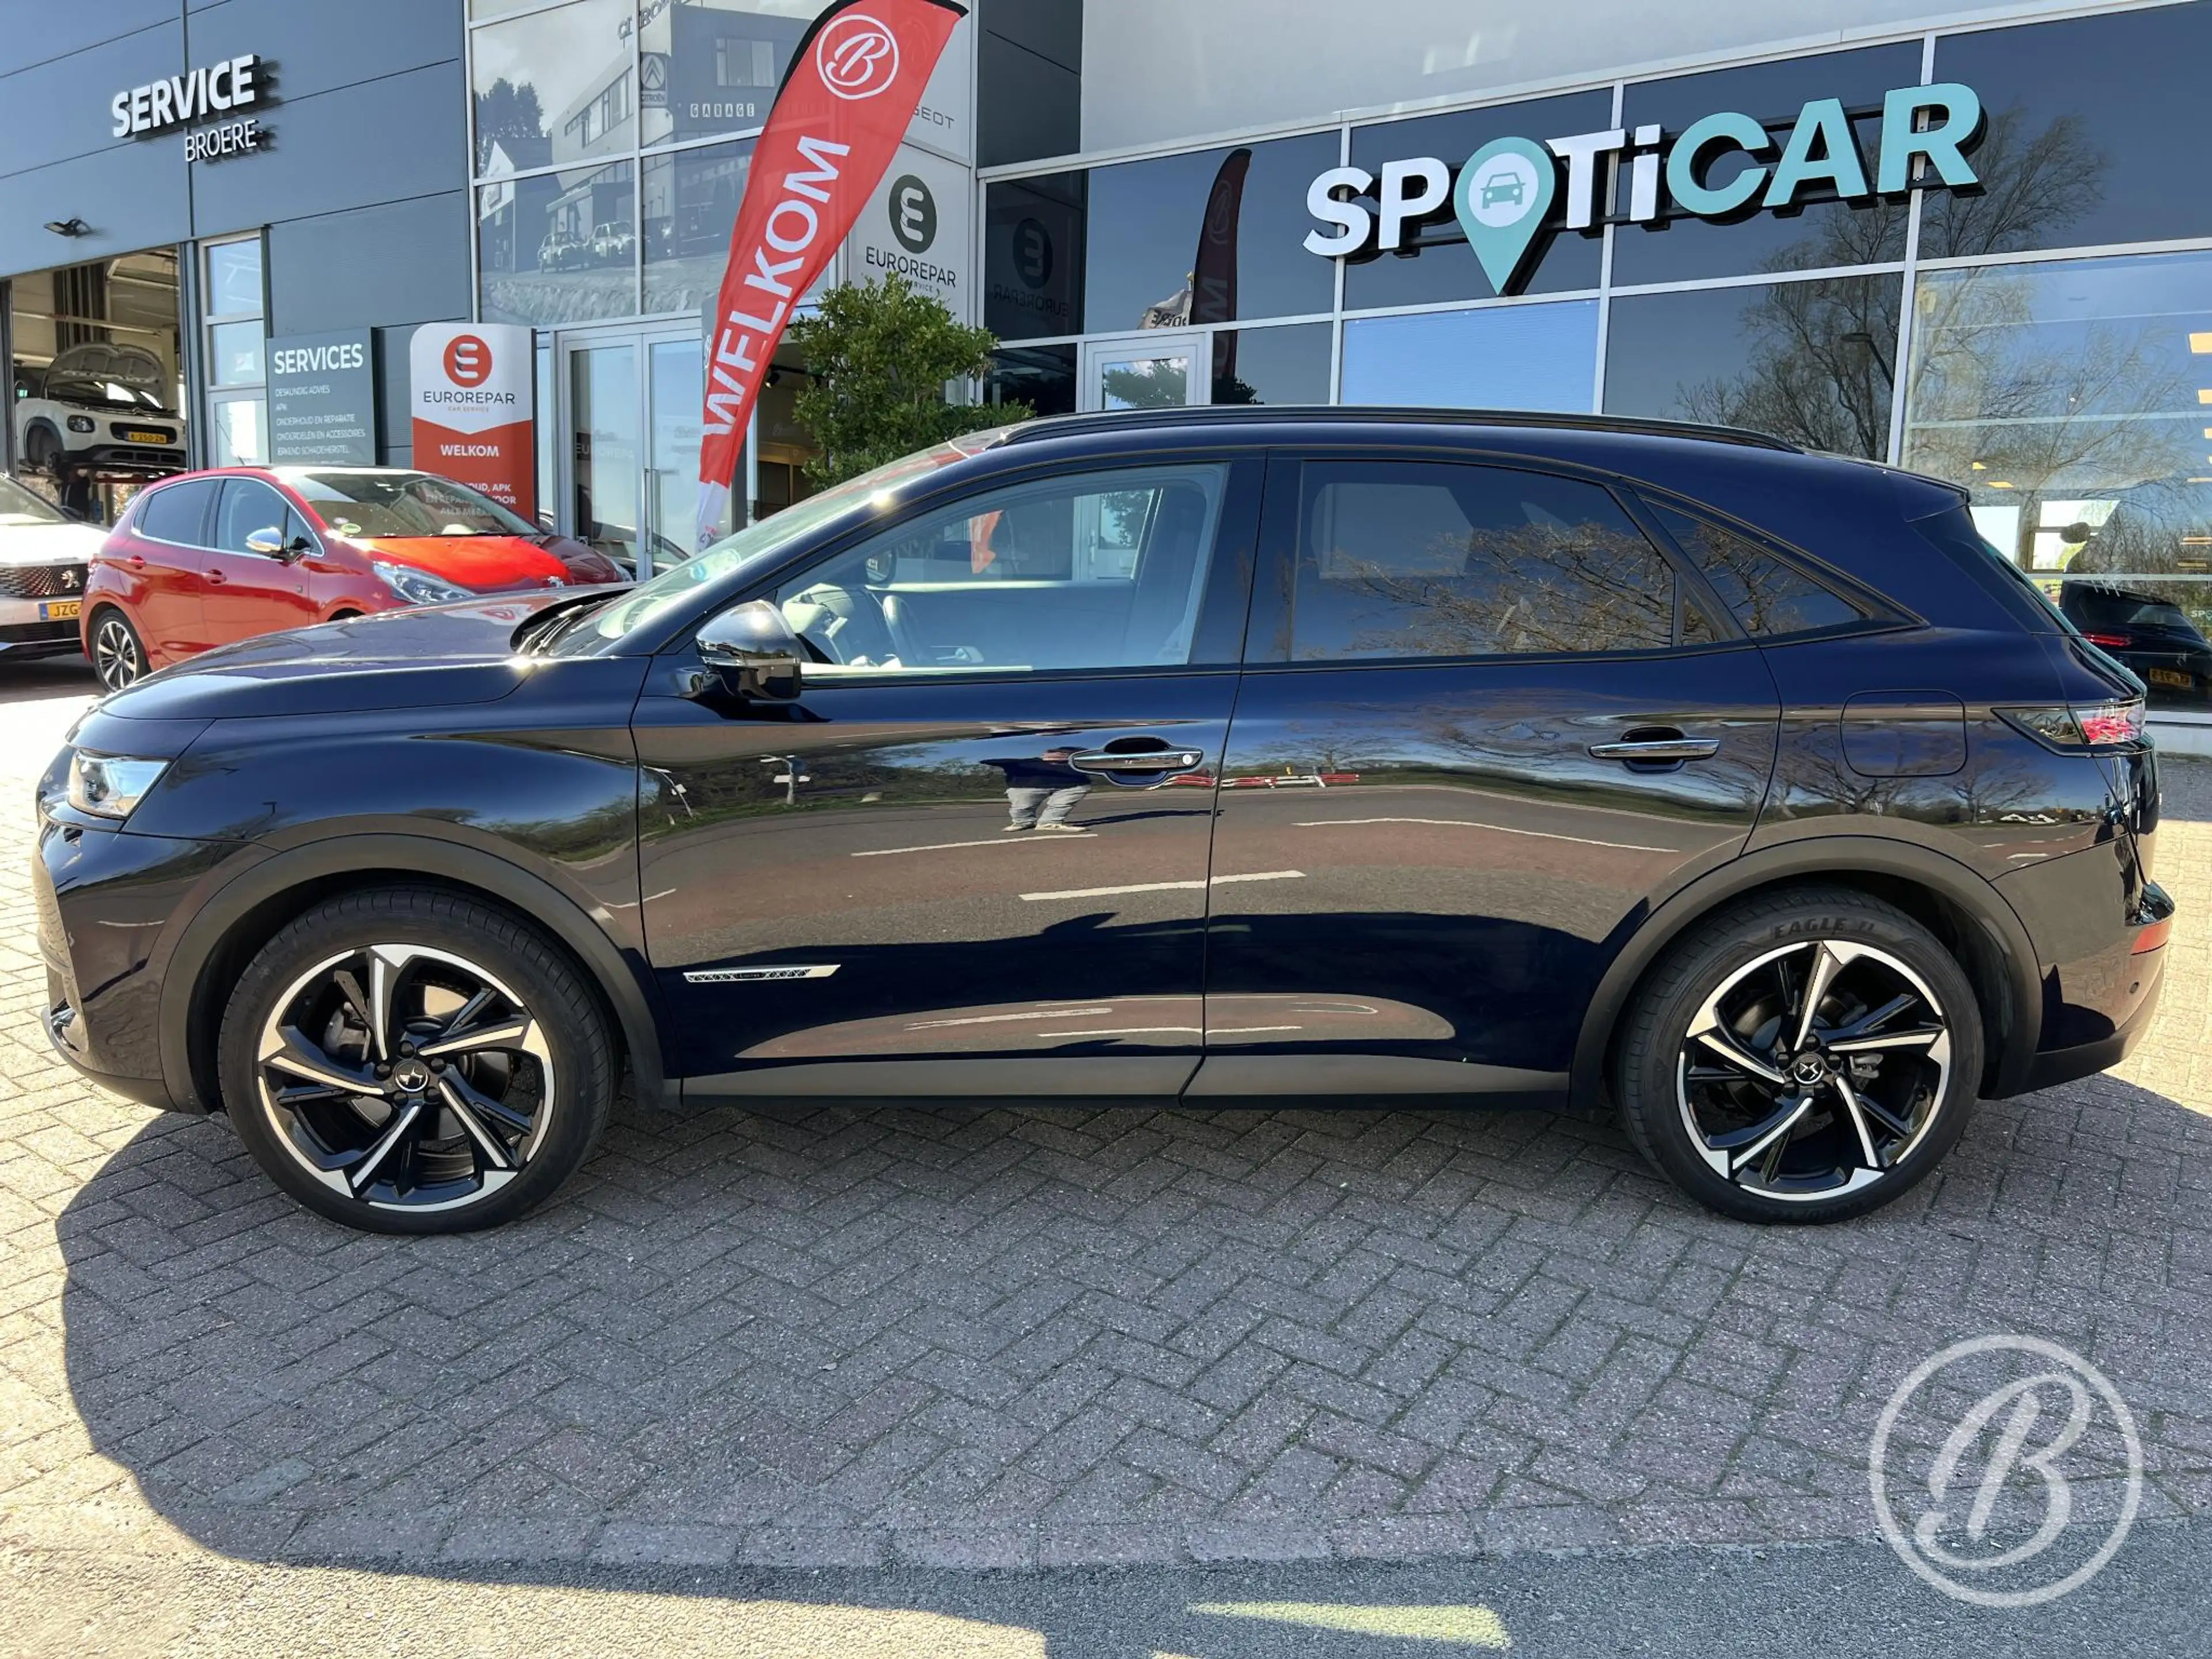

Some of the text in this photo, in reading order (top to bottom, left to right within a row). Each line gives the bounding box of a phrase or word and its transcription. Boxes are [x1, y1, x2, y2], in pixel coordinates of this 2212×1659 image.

[112, 54, 255, 138] SERVICE
[690, 103, 755, 118] GARAGE
[185, 119, 257, 162] BROERE
[865, 246, 956, 288] EUROREPAR
[274, 343, 364, 374] SERVICES
[423, 391, 516, 404] EUROREPAR
[440, 444, 500, 457] WELKOM
[492, 483, 512, 493] APK
[1774, 917, 1848, 940] EAGLE
